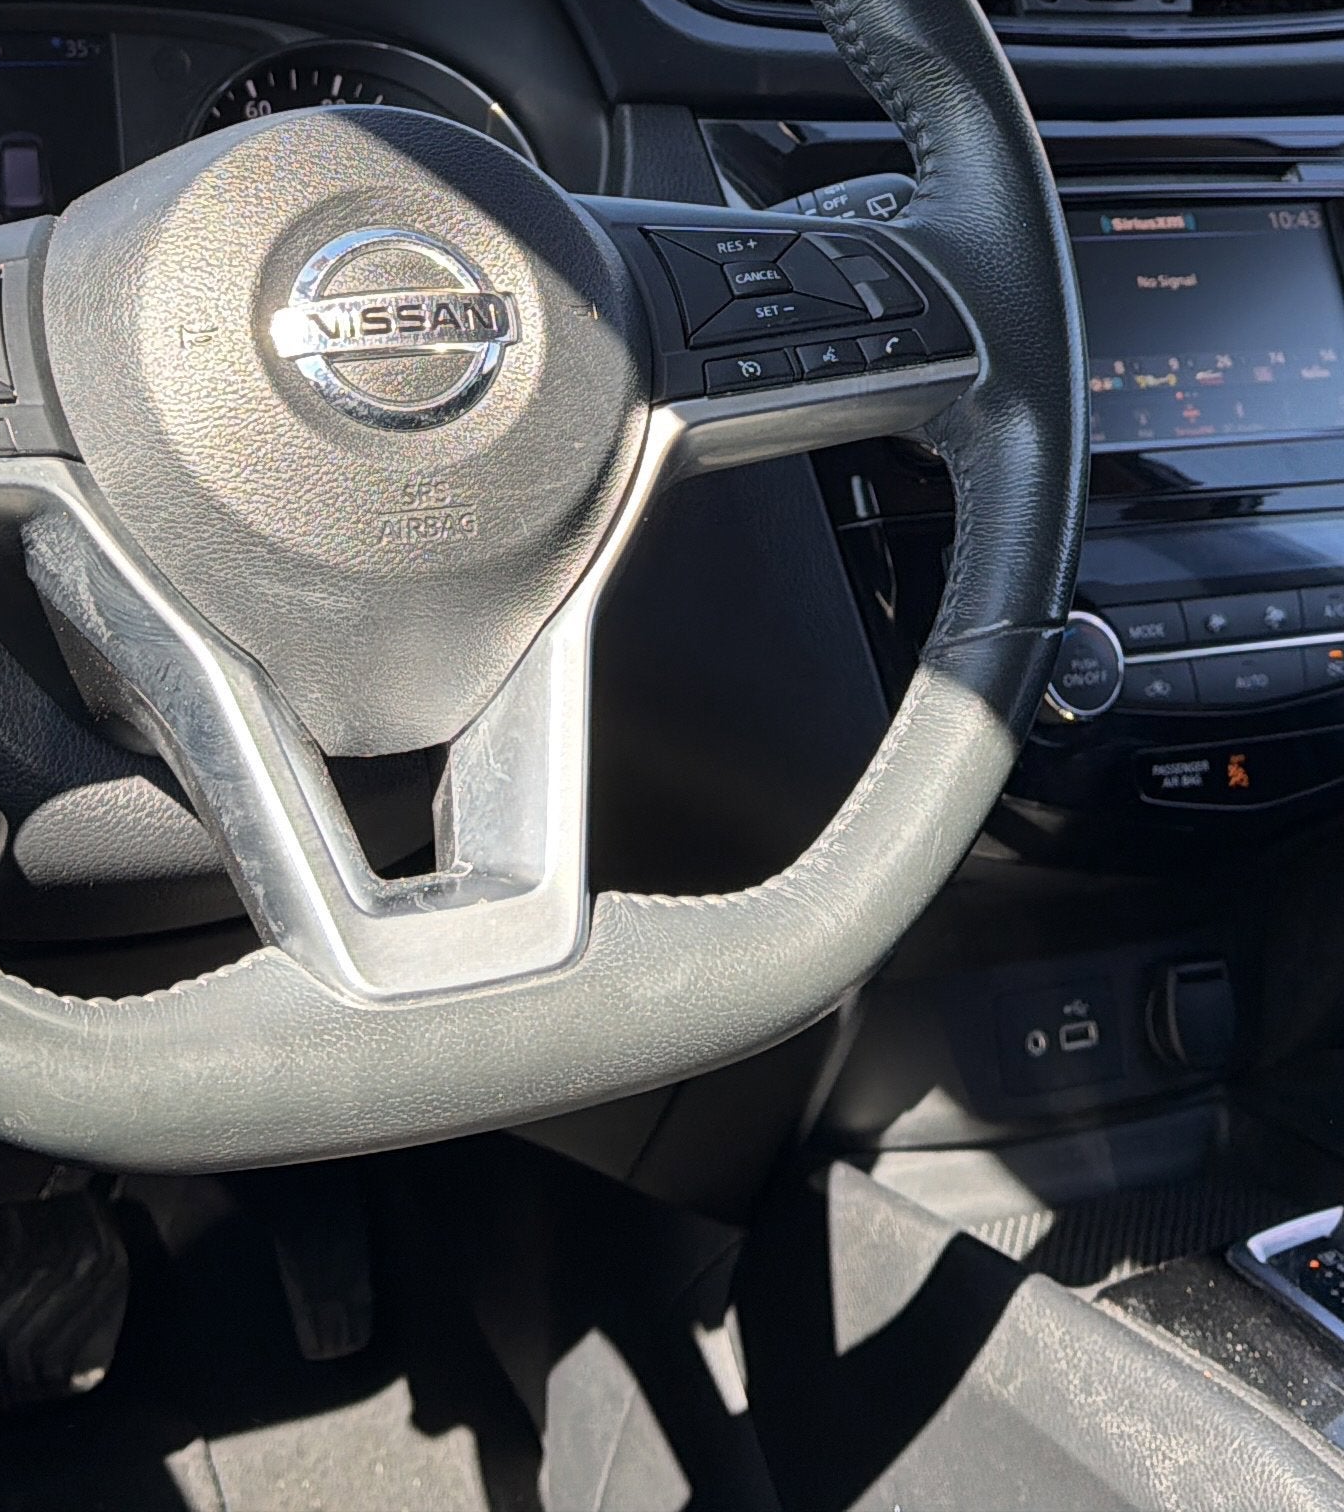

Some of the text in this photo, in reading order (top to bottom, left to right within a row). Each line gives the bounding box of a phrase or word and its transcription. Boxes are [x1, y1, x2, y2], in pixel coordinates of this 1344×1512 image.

[245, 99, 272, 119] 60
[823, 194, 849, 211] OFF
[1267, 209, 1323, 230] 10:43
[717, 239, 743, 255] RES
[735, 269, 782, 284] CANCEL
[756, 305, 780, 319] SET
[306, 303, 498, 340] NISSAN
[1128, 622, 1166, 641] MODE
[1235, 673, 1271, 691] AUTO
